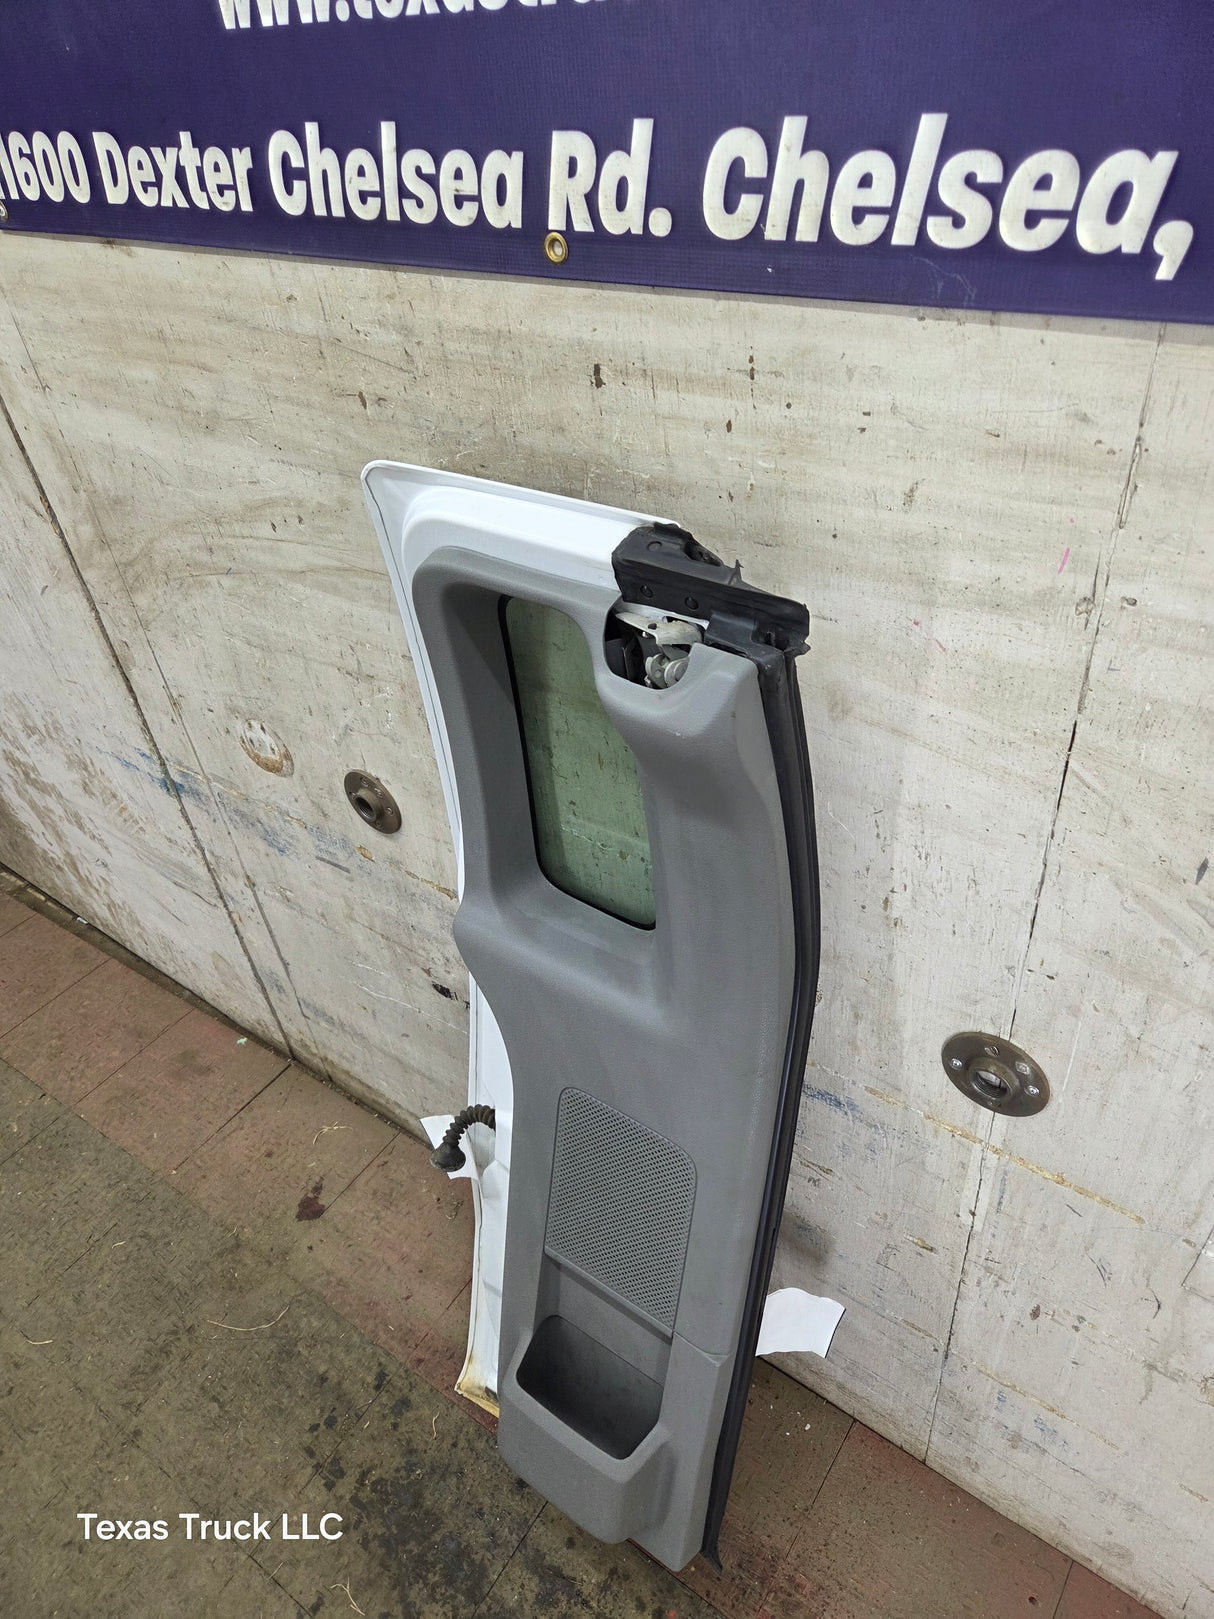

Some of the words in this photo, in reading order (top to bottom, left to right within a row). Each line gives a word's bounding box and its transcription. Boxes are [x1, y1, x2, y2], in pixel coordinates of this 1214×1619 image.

[0, 131, 91, 204] 1600
[92, 131, 254, 212] Dexter
[267, 120, 524, 229] Chelsea
[547, 118, 672, 237] Rd.
[702, 112, 1194, 281] Chelsea,
